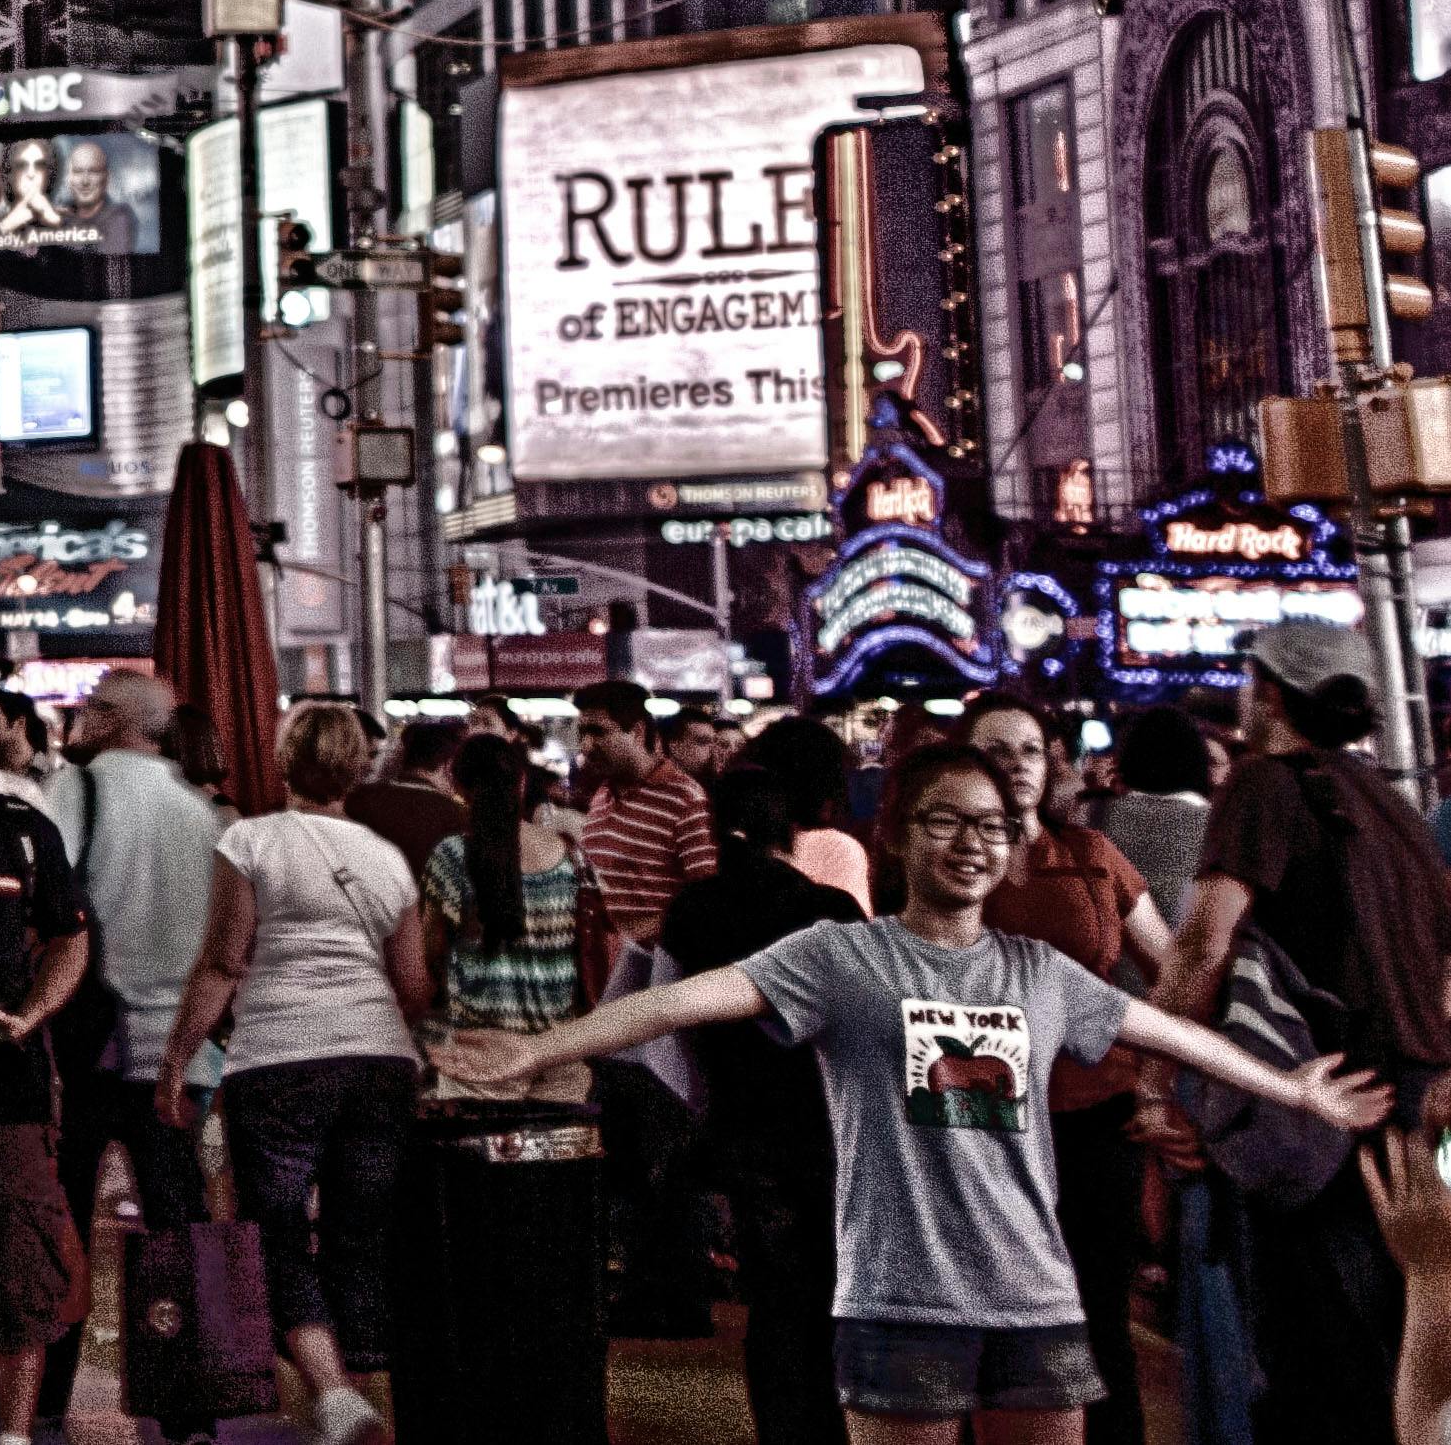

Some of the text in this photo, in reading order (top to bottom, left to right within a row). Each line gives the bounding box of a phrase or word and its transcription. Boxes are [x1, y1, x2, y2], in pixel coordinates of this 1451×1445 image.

[9, 72, 83, 114] NBC
[26, 226, 104, 246] America.
[558, 303, 607, 342] of
[536, 367, 826, 418] Premieres This
[300, 460, 318, 556] THOMSON
[684, 485, 819, 503] THOMSON REUTERS
[662, 517, 773, 548] eurpa
[1166, 521, 1302, 560] Hard Rock
[909, 1008, 1024, 1032] NEW YORK
